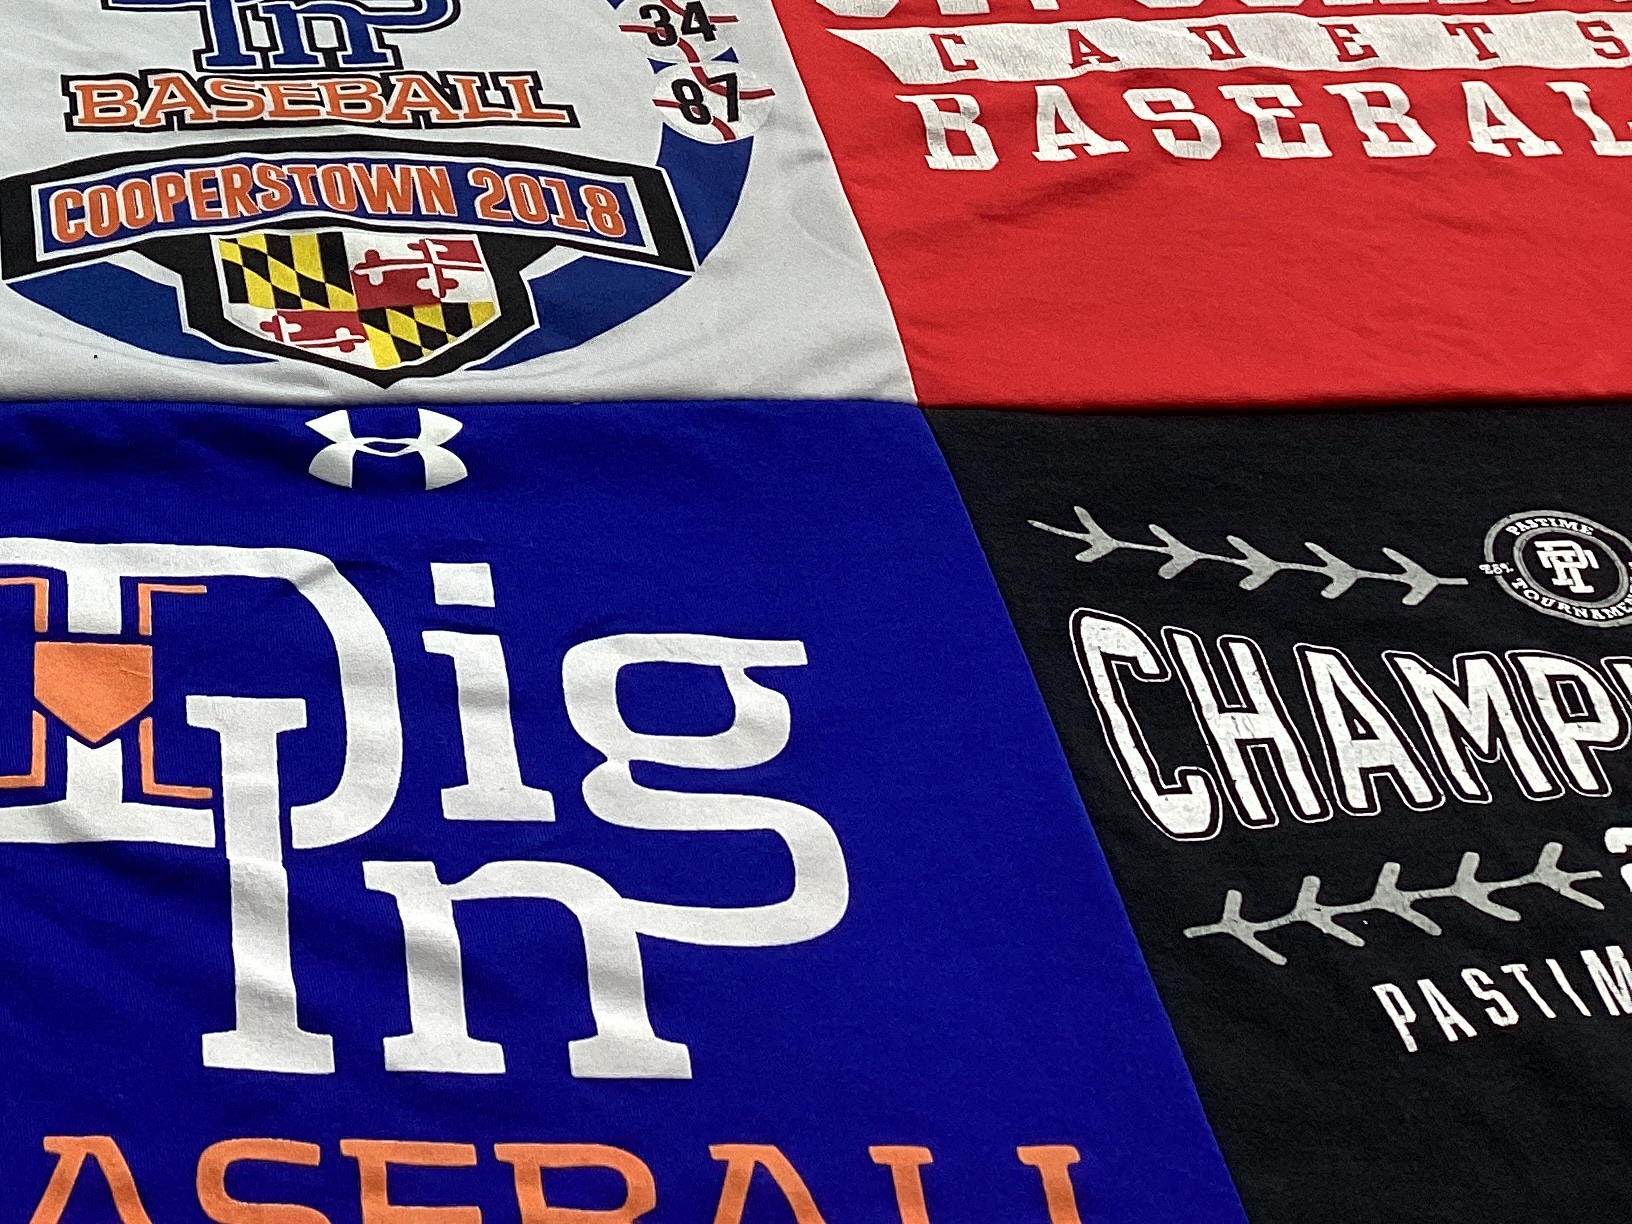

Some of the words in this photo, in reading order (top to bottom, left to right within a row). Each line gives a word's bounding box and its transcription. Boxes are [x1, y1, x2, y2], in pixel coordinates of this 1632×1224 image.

[638, 0, 718, 48] 34
[927, 19, 1632, 74] CADETS
[61, 72, 581, 134] BASEBALL
[670, 71, 742, 126] 87
[895, 80, 1632, 172] BASEBAL
[50, 163, 459, 244] COOPERSTOWN
[470, 167, 628, 239] 2018
[1505, 518, 1595, 536] PASTIME
[1069, 607, 1632, 842] CHAMP
[185, 695, 693, 1080] In
[1371, 945, 1632, 1053] PASTIM
